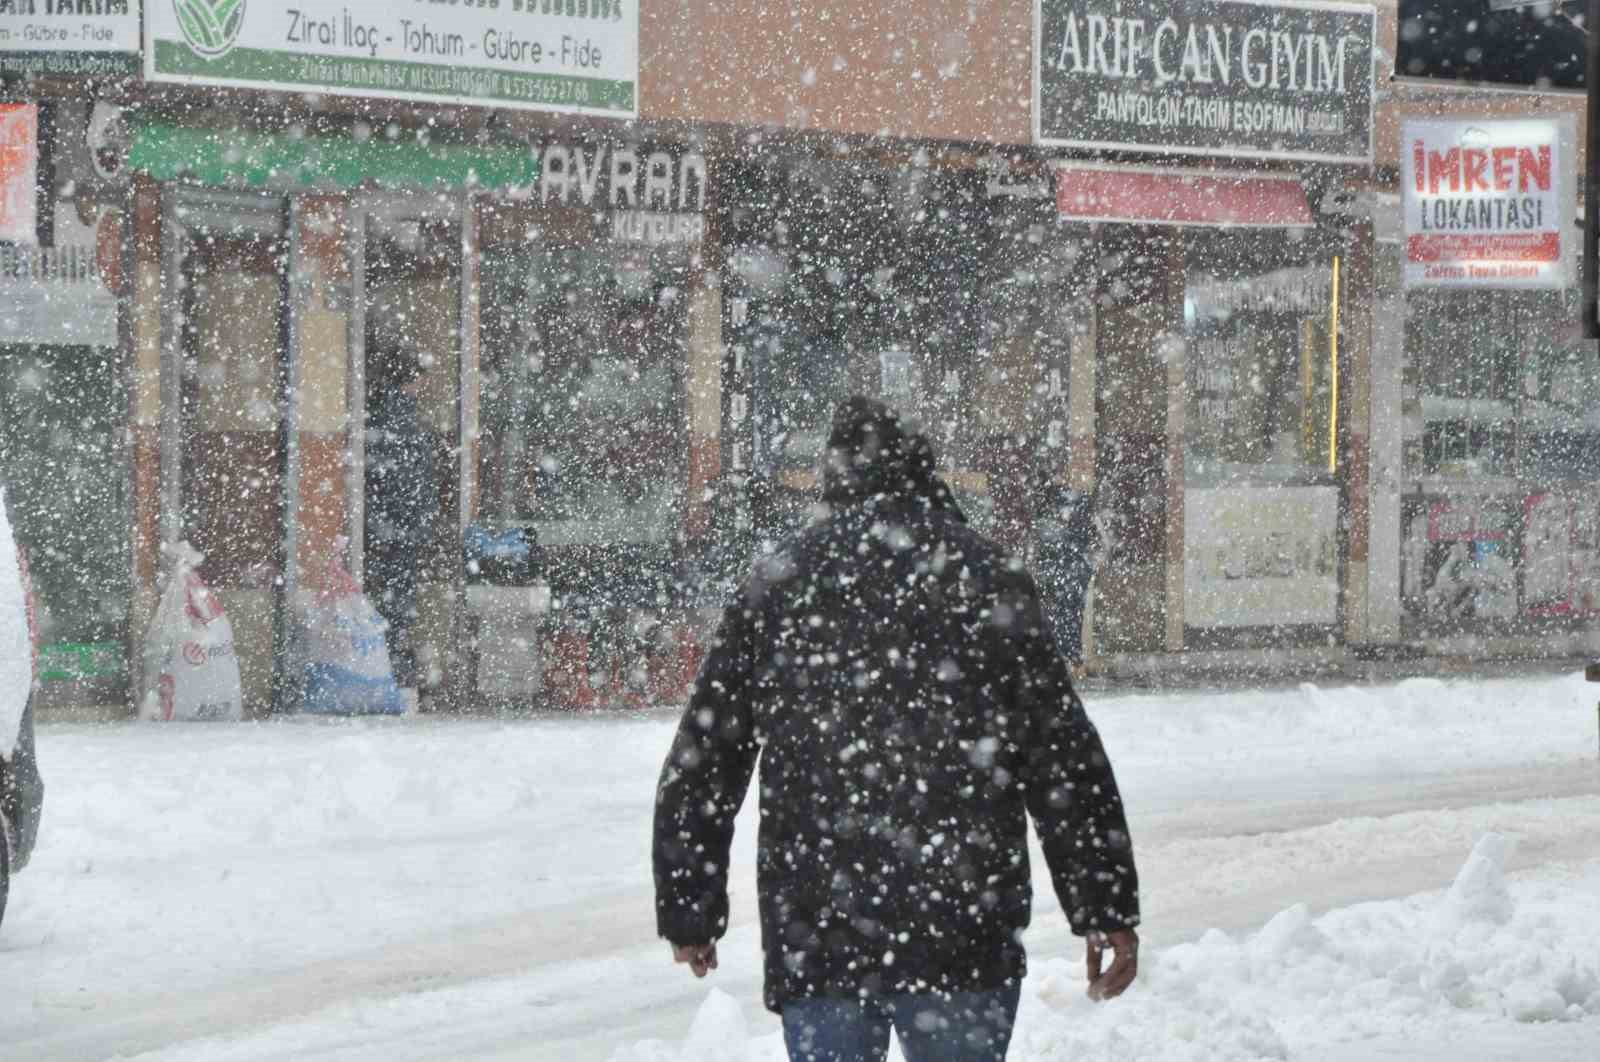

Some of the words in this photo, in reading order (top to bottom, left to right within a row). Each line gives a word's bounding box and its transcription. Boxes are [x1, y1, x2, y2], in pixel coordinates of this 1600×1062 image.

[82, 23, 113, 41] Fide
[286, 9, 336, 45] Zirai
[343, 8, 379, 57] İlaç
[400, 19, 464, 56] Tohum
[483, 28, 542, 63] Gübre
[561, 35, 602, 68] Fide
[1241, 13, 1345, 94] GİYİM
[512, 145, 706, 206] AVRAN
[1413, 139, 1551, 194] İMREN
[1421, 199, 1542, 230] LOKANTASI
